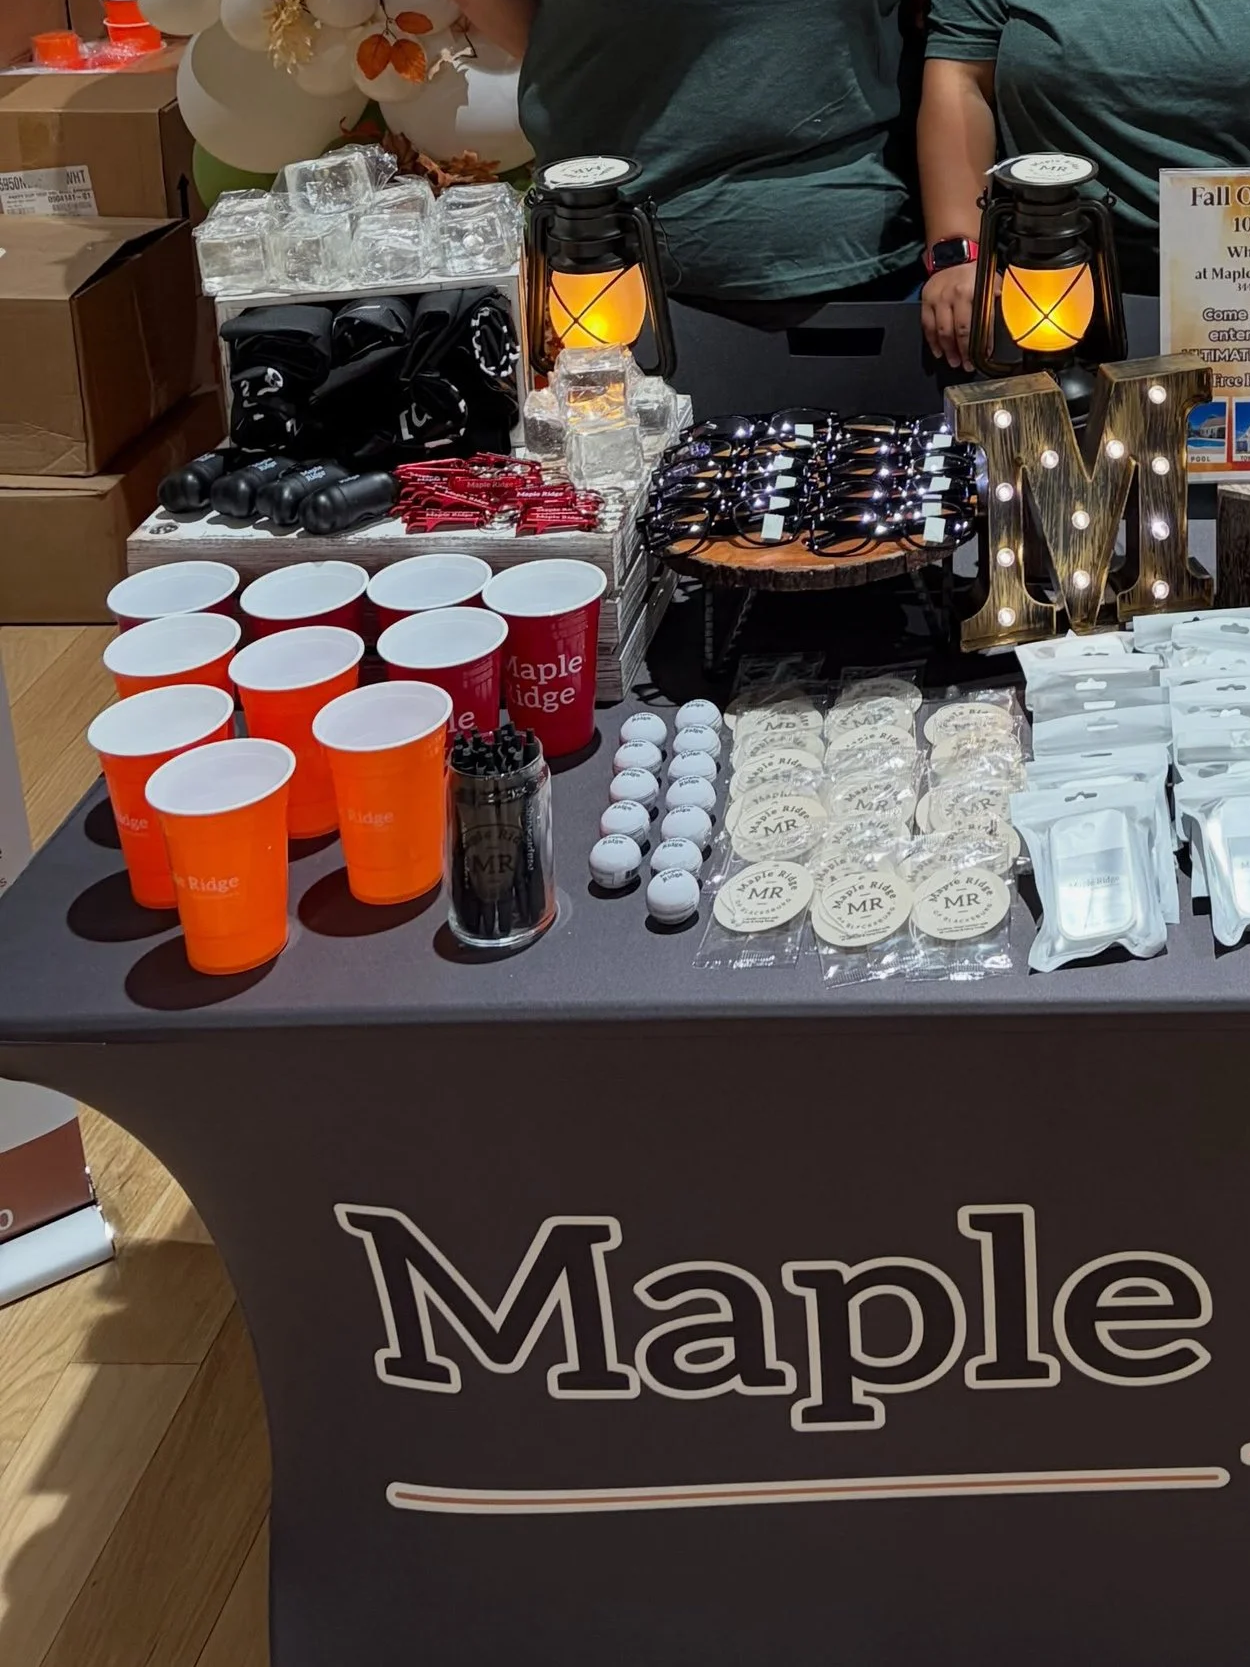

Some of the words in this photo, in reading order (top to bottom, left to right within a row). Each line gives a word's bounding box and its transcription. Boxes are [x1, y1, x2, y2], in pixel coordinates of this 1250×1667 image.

[1191, 186, 1230, 206] Fall
[1195, 268, 1207, 279] at
[1203, 308, 1248, 321] Come
[1212, 373, 1243, 387] Free
[944, 354, 1216, 652] M
[505, 654, 582, 685] Maple
[746, 761, 773, 784] Maple
[855, 799, 889, 812] MR
[960, 797, 996, 816] MR
[348, 808, 394, 827] Ridge
[749, 808, 777, 834] Maple
[783, 805, 809, 820] Ridge
[764, 819, 798, 836] MR
[471, 854, 515, 875] MR
[188, 875, 240, 893] Ridge
[736, 871, 774, 892] Maple
[778, 870, 798, 891] Ridge
[966, 877, 993, 896] Ridge
[747, 886, 783, 900] MR
[832, 884, 865, 910] Maple
[870, 881, 896, 899] Ridge
[944, 893, 980, 909] MR
[847, 897, 884, 915] MR
[333, 1202, 1214, 1432] Maple
